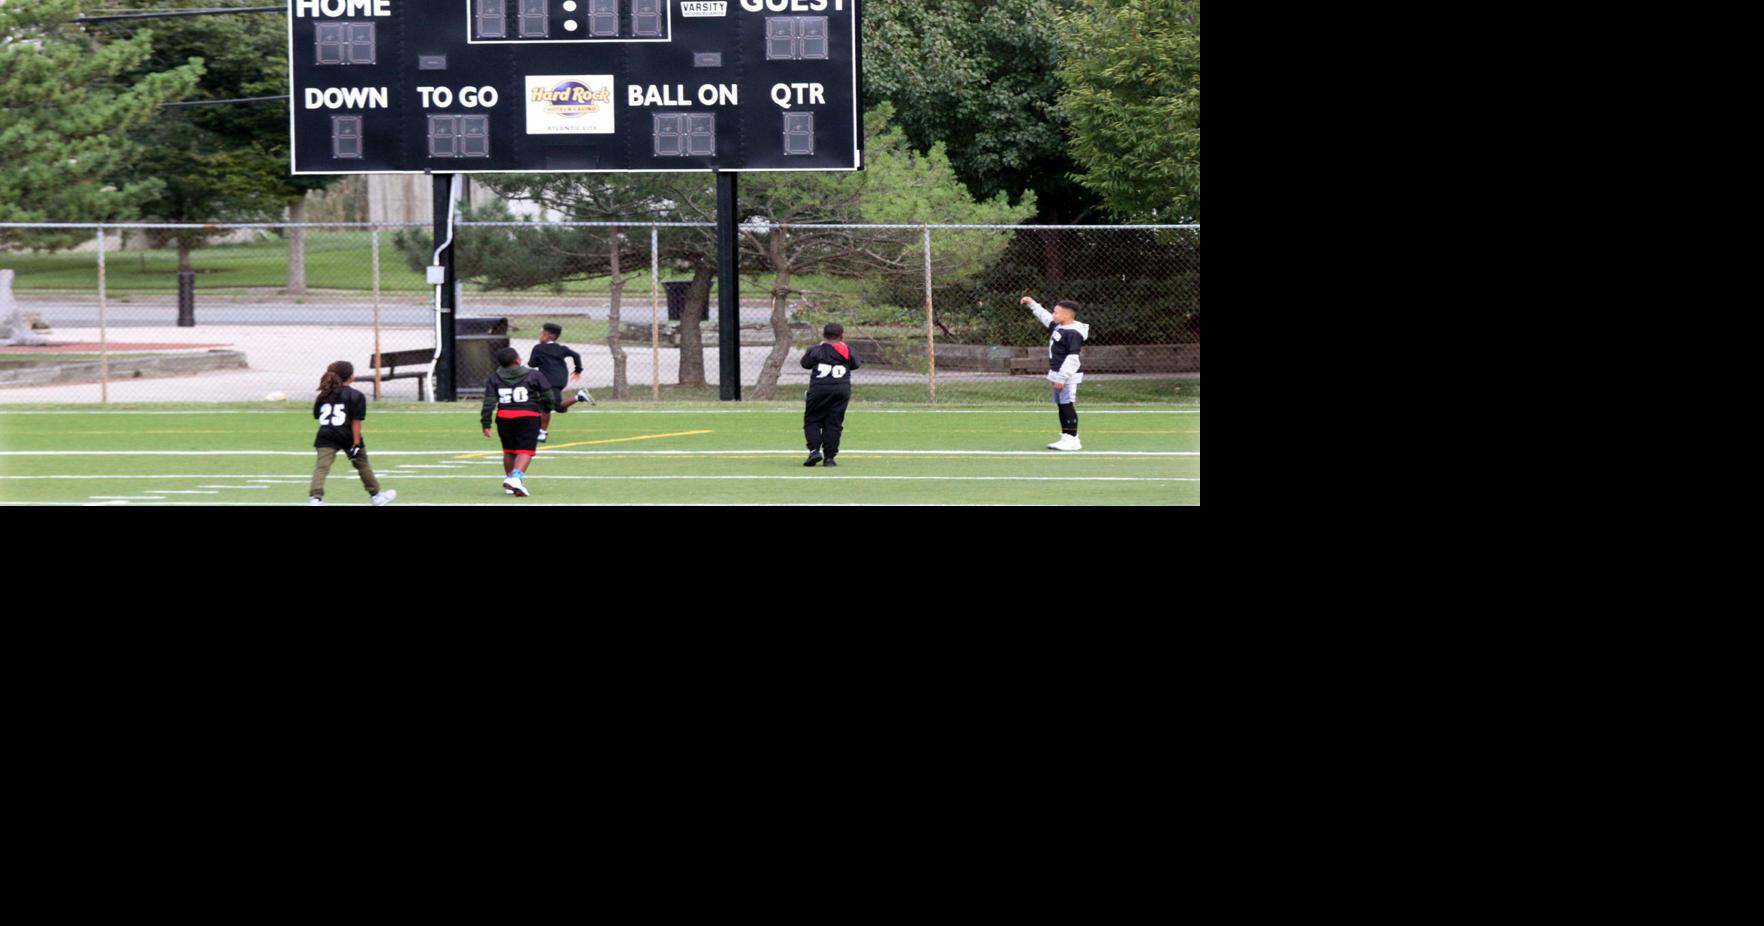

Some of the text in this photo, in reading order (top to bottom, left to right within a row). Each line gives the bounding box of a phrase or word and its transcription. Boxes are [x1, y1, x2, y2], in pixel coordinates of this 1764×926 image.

[296, 0, 391, 17] HOME
[683, 2, 725, 12] VARSITY
[304, 87, 388, 109] DOWN
[417, 86, 498, 108] TO GO
[531, 86, 610, 103] Hard Rock
[628, 84, 738, 106] BALL ON
[771, 83, 825, 108] QTR
[319, 403, 346, 426] 25
